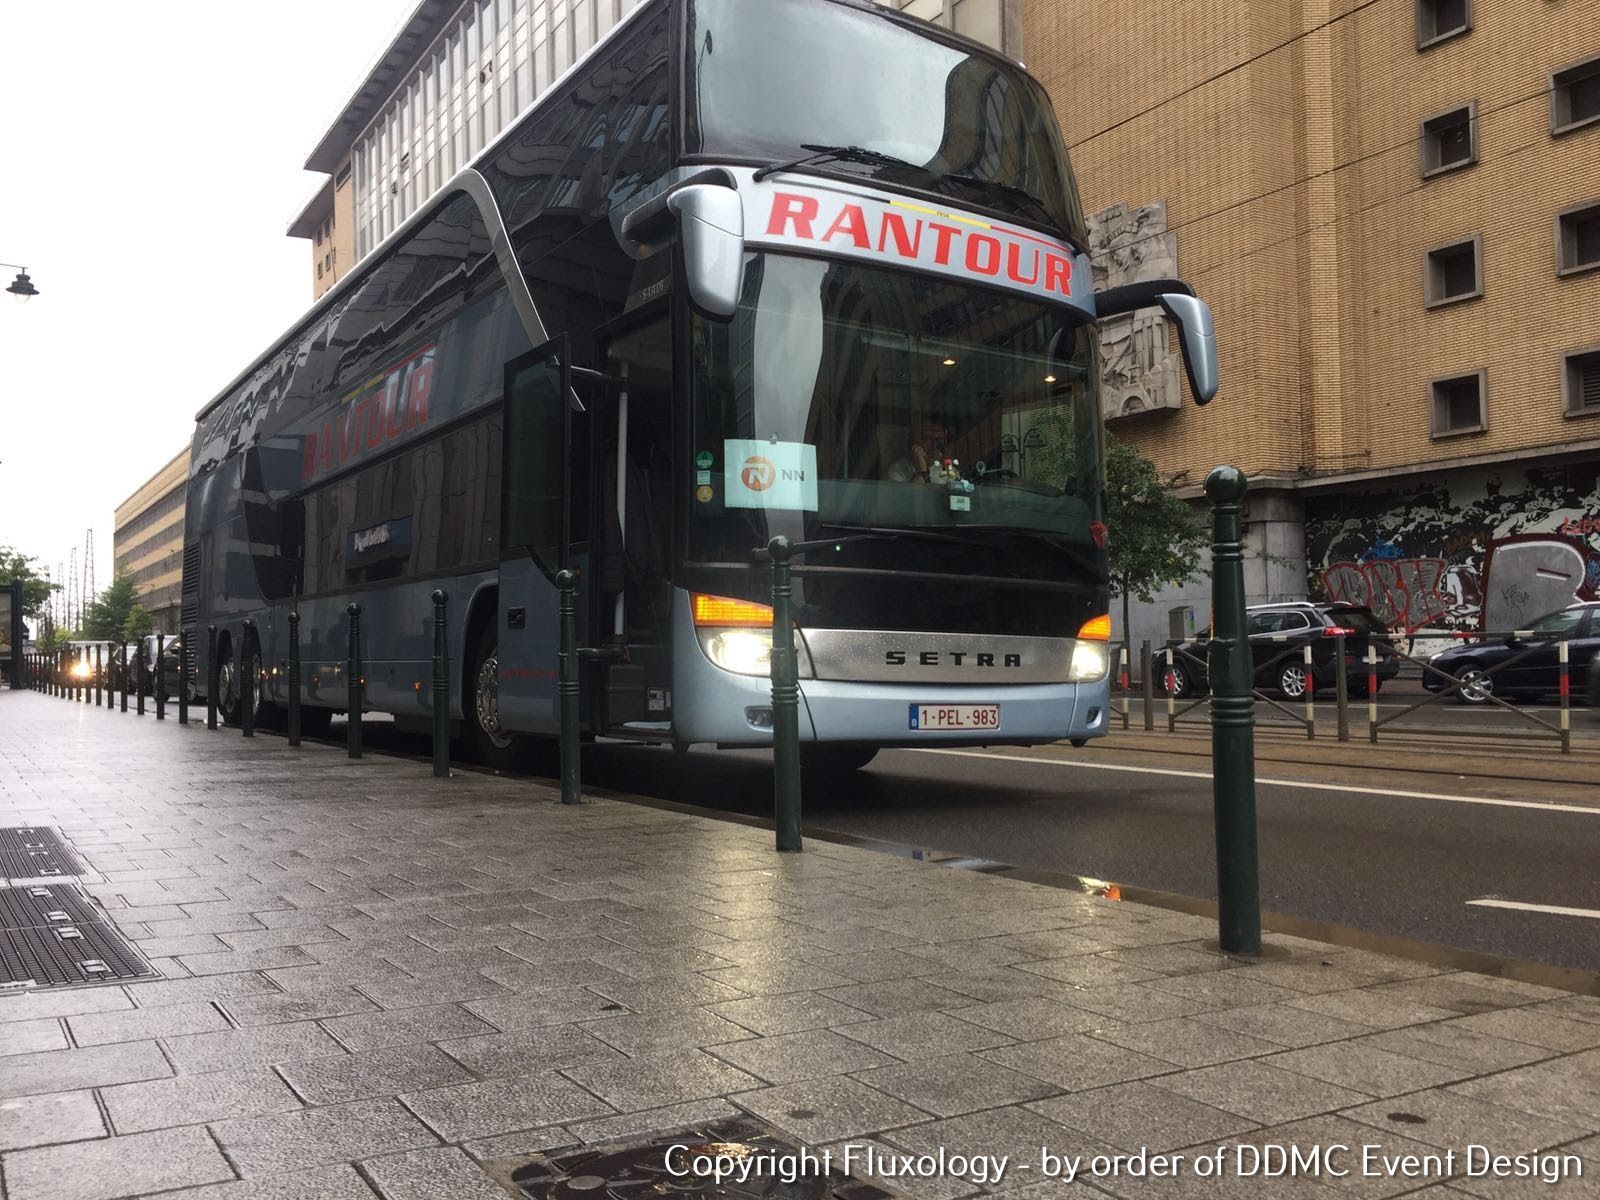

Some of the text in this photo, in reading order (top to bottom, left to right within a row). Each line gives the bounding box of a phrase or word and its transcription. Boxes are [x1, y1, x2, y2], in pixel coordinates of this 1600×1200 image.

[765, 191, 1073, 298] RANTOUR
[301, 357, 434, 481] RANTOUR
[781, 468, 805, 482] NN
[885, 651, 1021, 667] SETRA
[921, 709, 997, 726] 1-PEL-983
